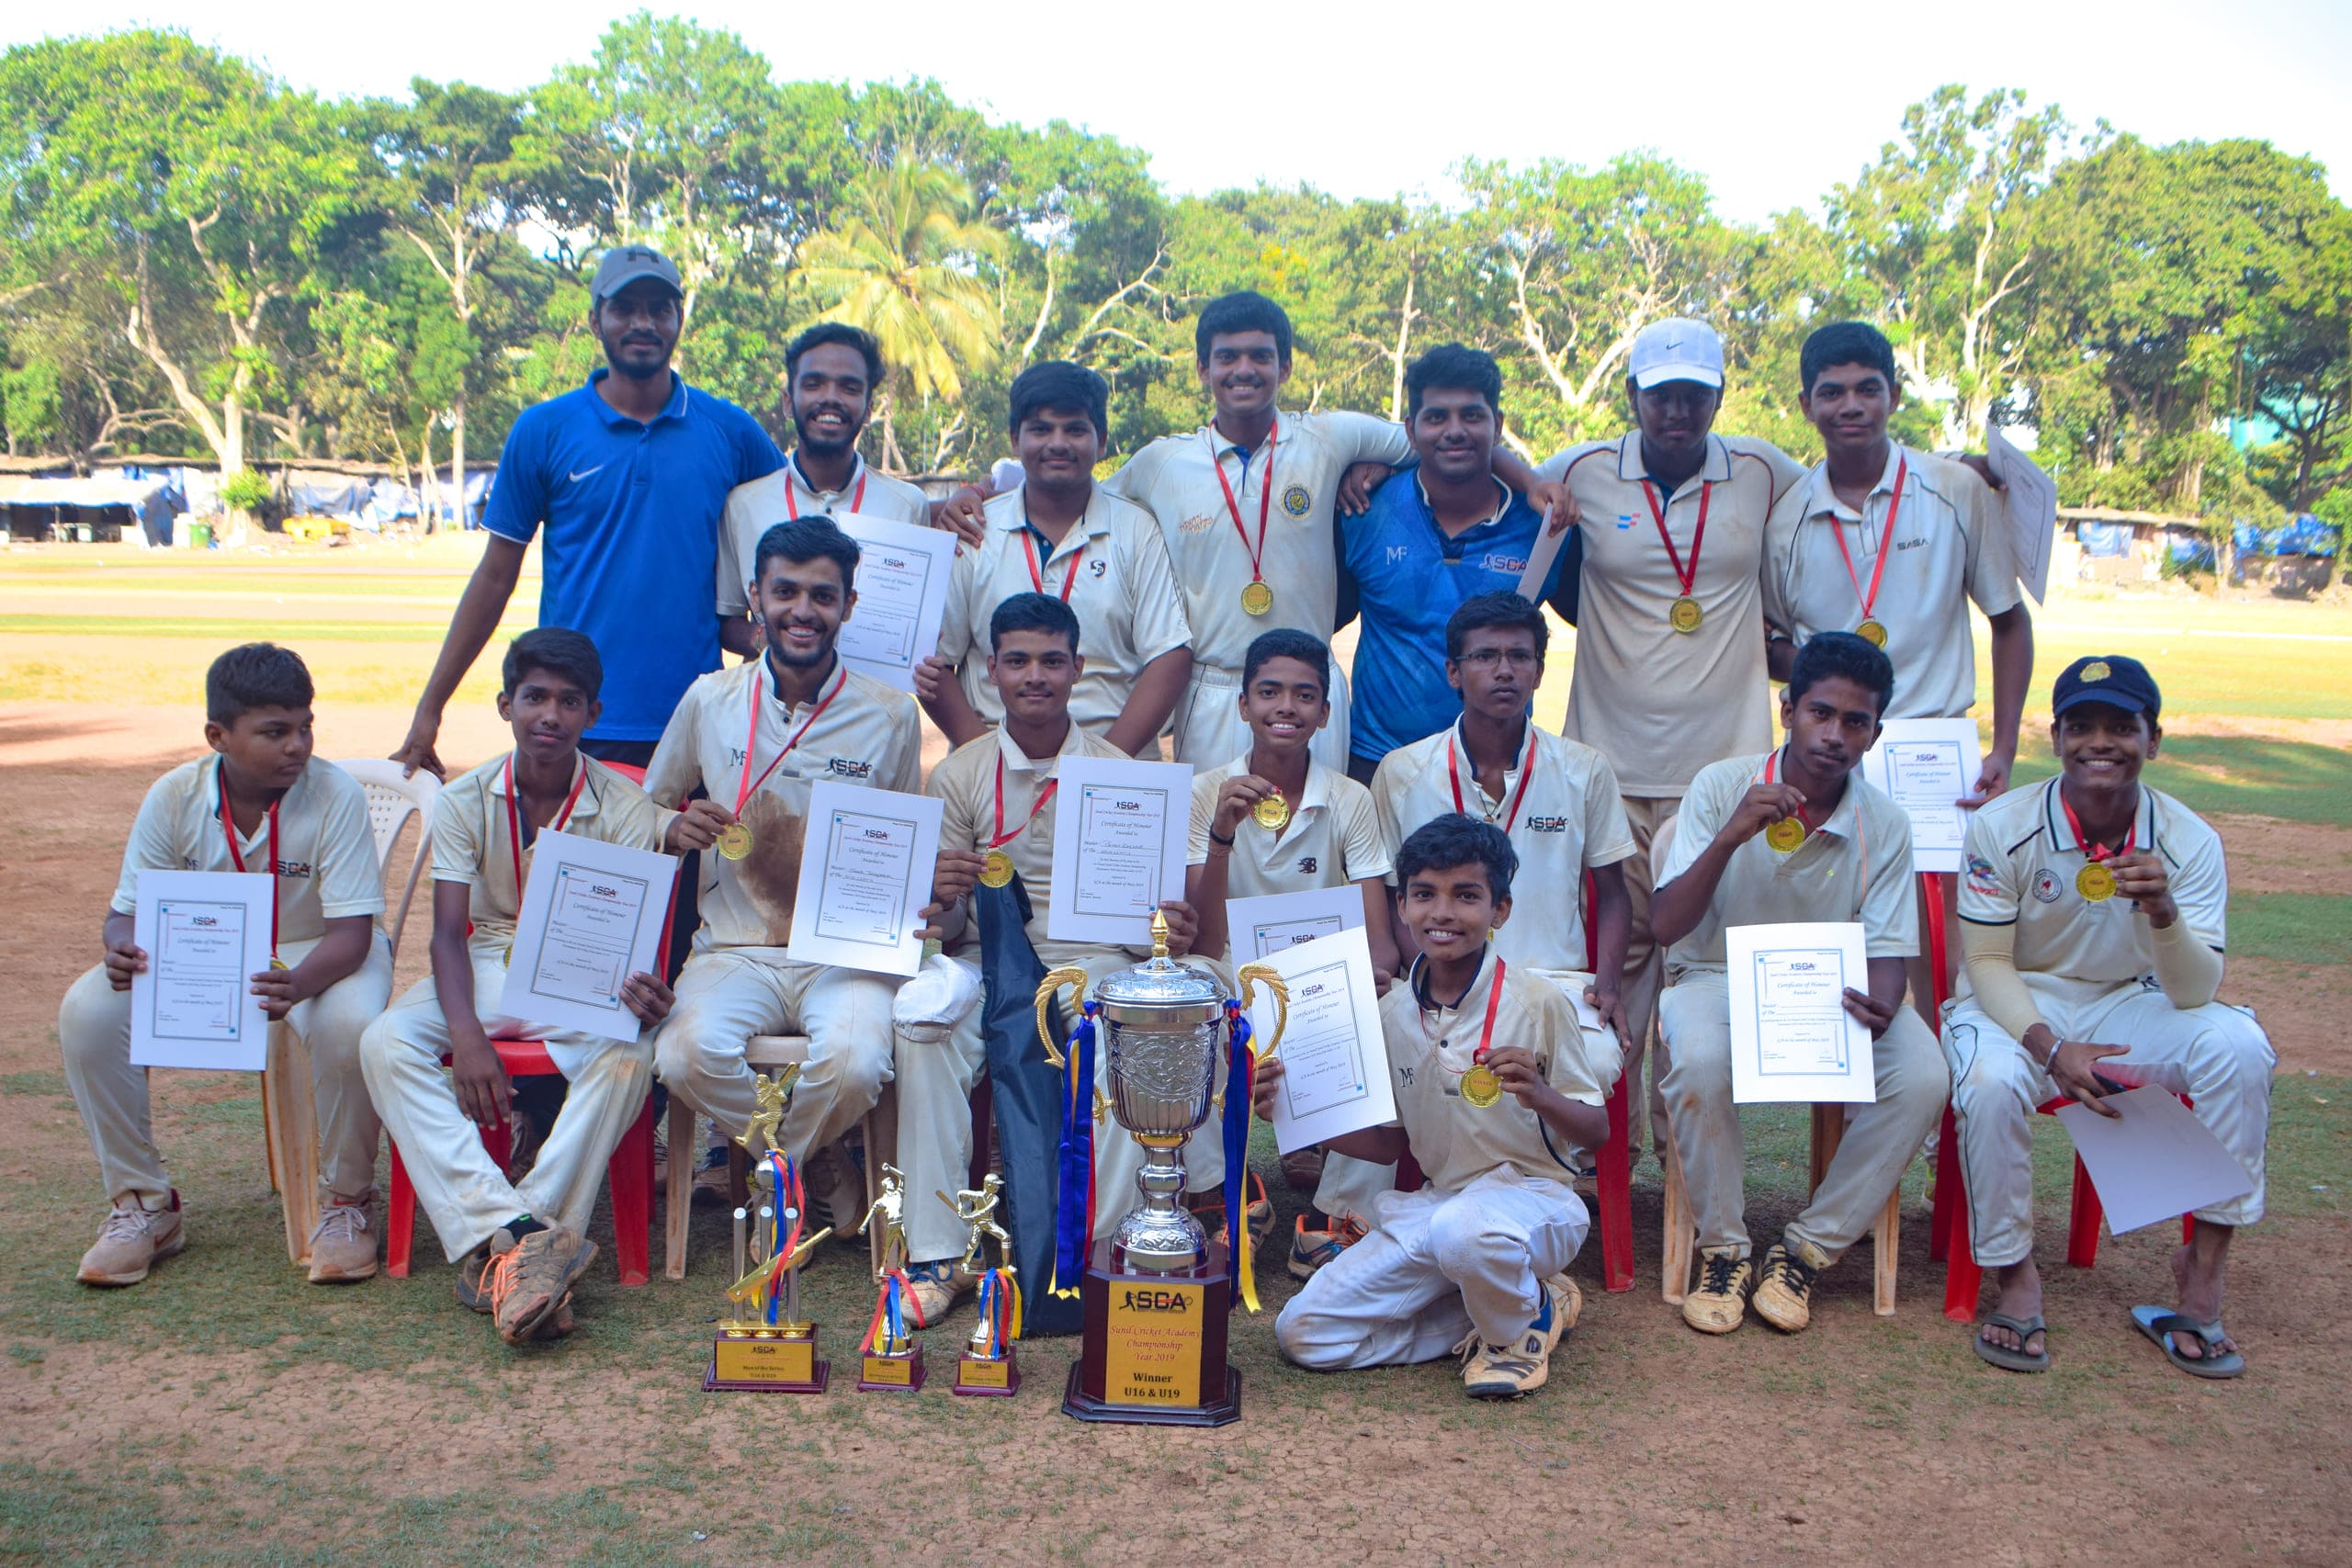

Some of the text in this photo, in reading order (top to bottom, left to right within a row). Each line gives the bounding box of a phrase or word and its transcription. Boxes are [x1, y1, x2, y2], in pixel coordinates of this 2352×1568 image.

[837, 760, 868, 773] SCA
[1534, 817, 1566, 829] SCA
[868, 829, 888, 839] SCA
[1296, 934, 1316, 944] SCA
[1306, 984, 1323, 996] SCA
[1398, 1067, 1414, 1088] MF
[1136, 1291, 1187, 1311] SCA
[1112, 1325, 1200, 1338] Sunil Cricket Academy
[757, 1346, 775, 1354] SCA
[1126, 1338, 1183, 1352] Championship
[1135, 1352, 1175, 1361] Year 2019
[1133, 1372, 1173, 1383] Winner
[1125, 1387, 1181, 1399] U16 & U19
